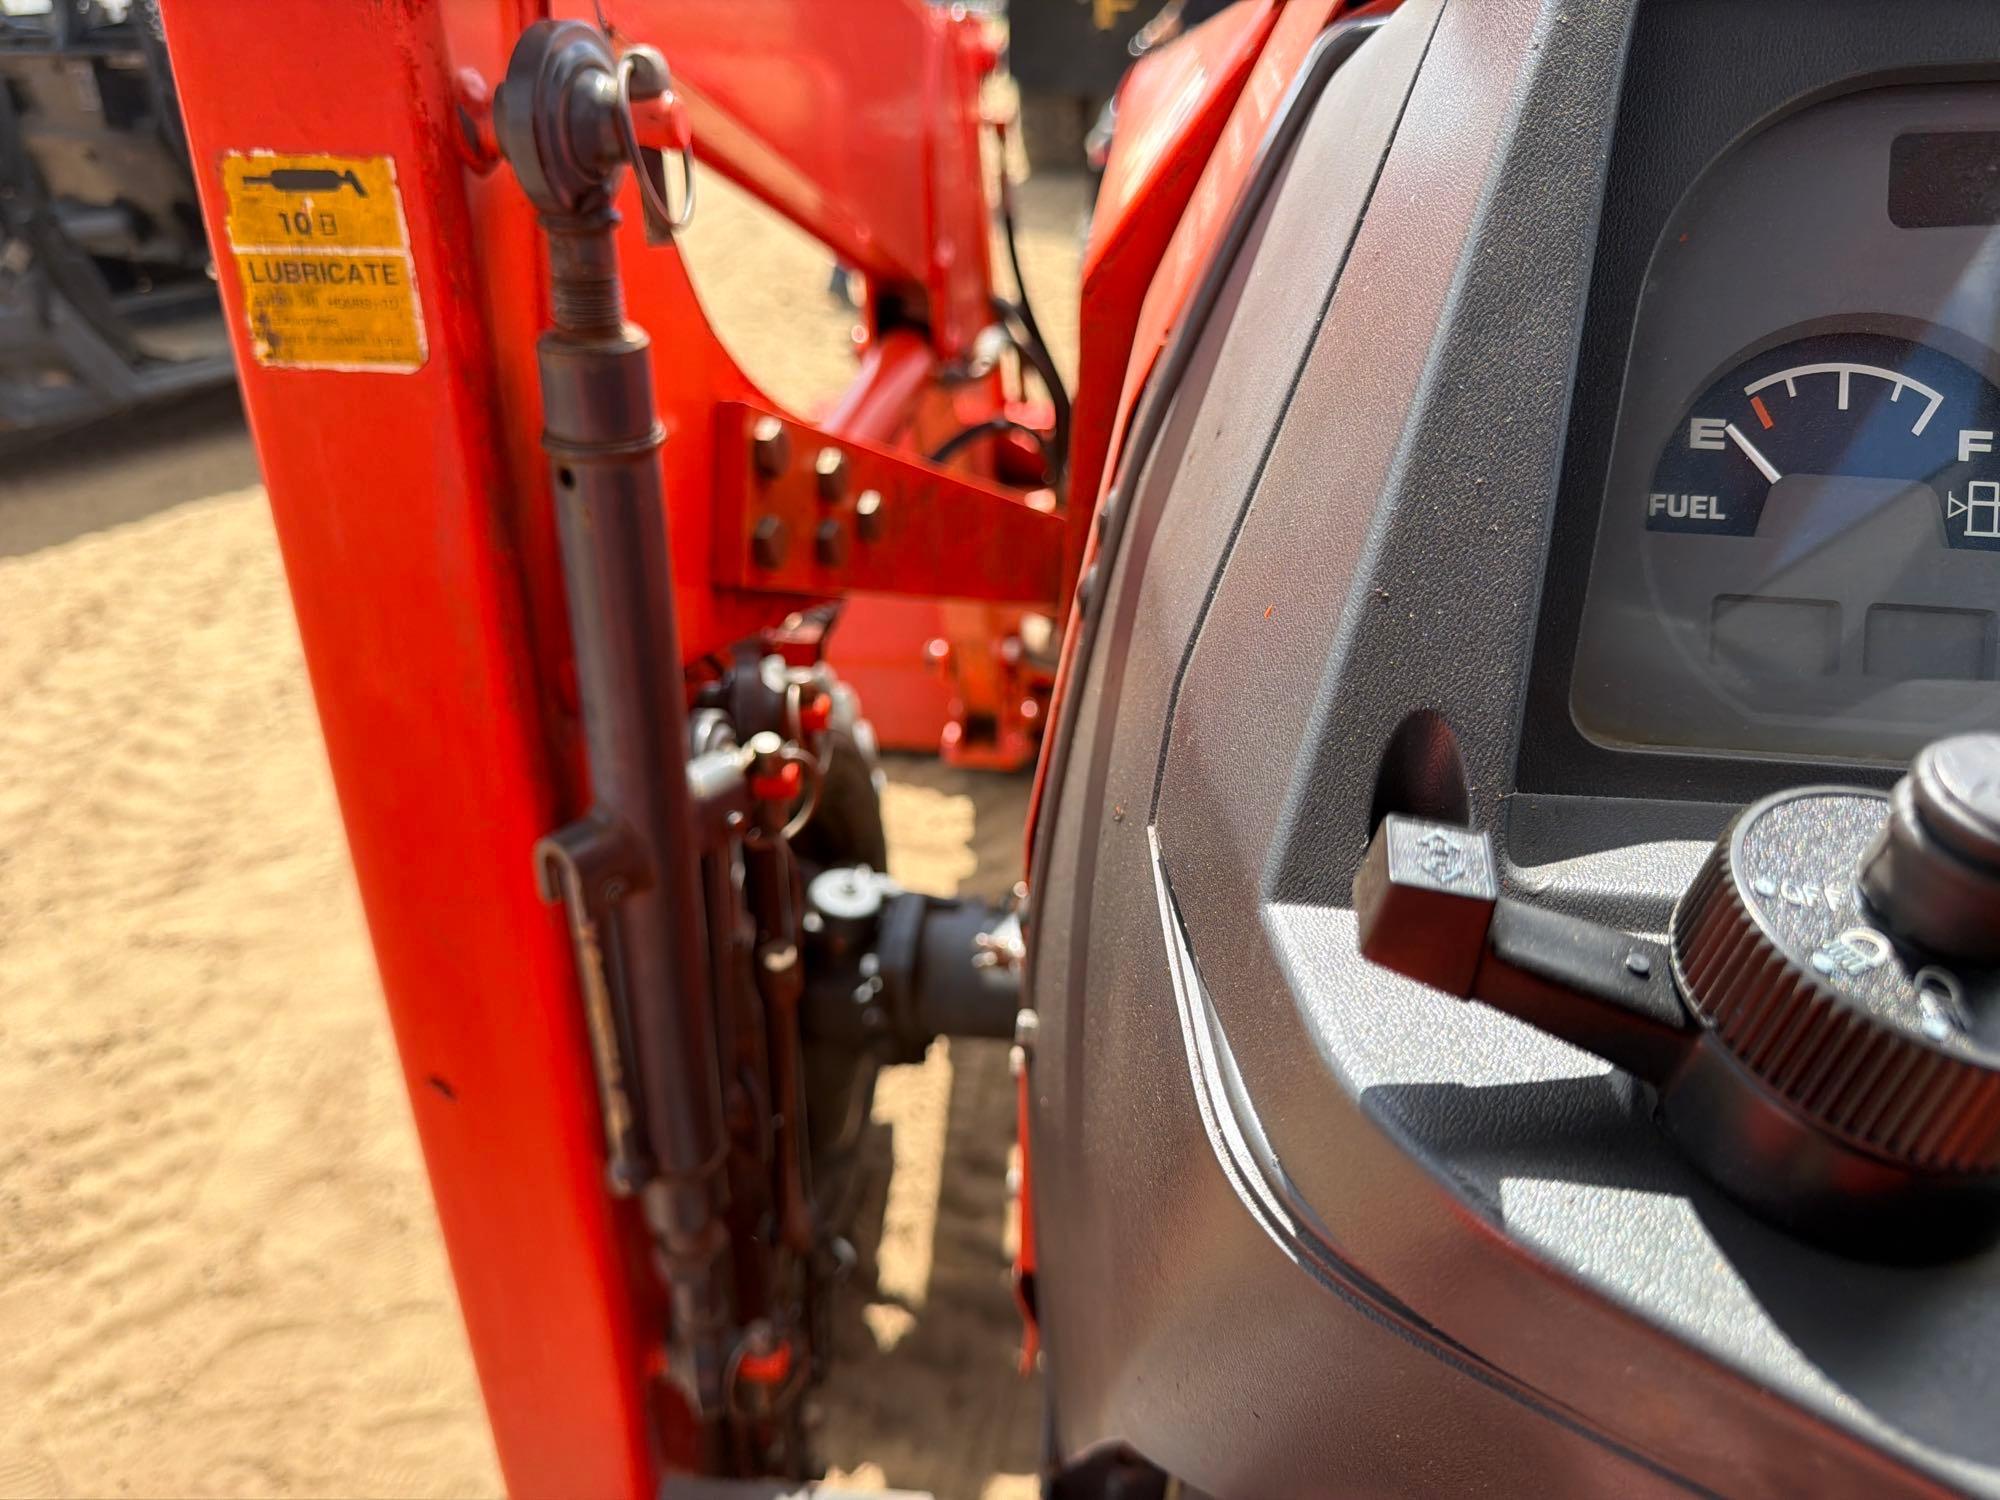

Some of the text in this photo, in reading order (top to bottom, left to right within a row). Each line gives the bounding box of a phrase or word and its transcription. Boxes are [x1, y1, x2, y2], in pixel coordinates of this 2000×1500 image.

[278, 212, 312, 236] 10
[249, 261, 399, 286] LUBRICATE
[1690, 418, 1726, 450] E
[1958, 429, 1994, 462] F
[1649, 493, 1726, 520] FUEL
[1781, 881, 1843, 911] OFF
